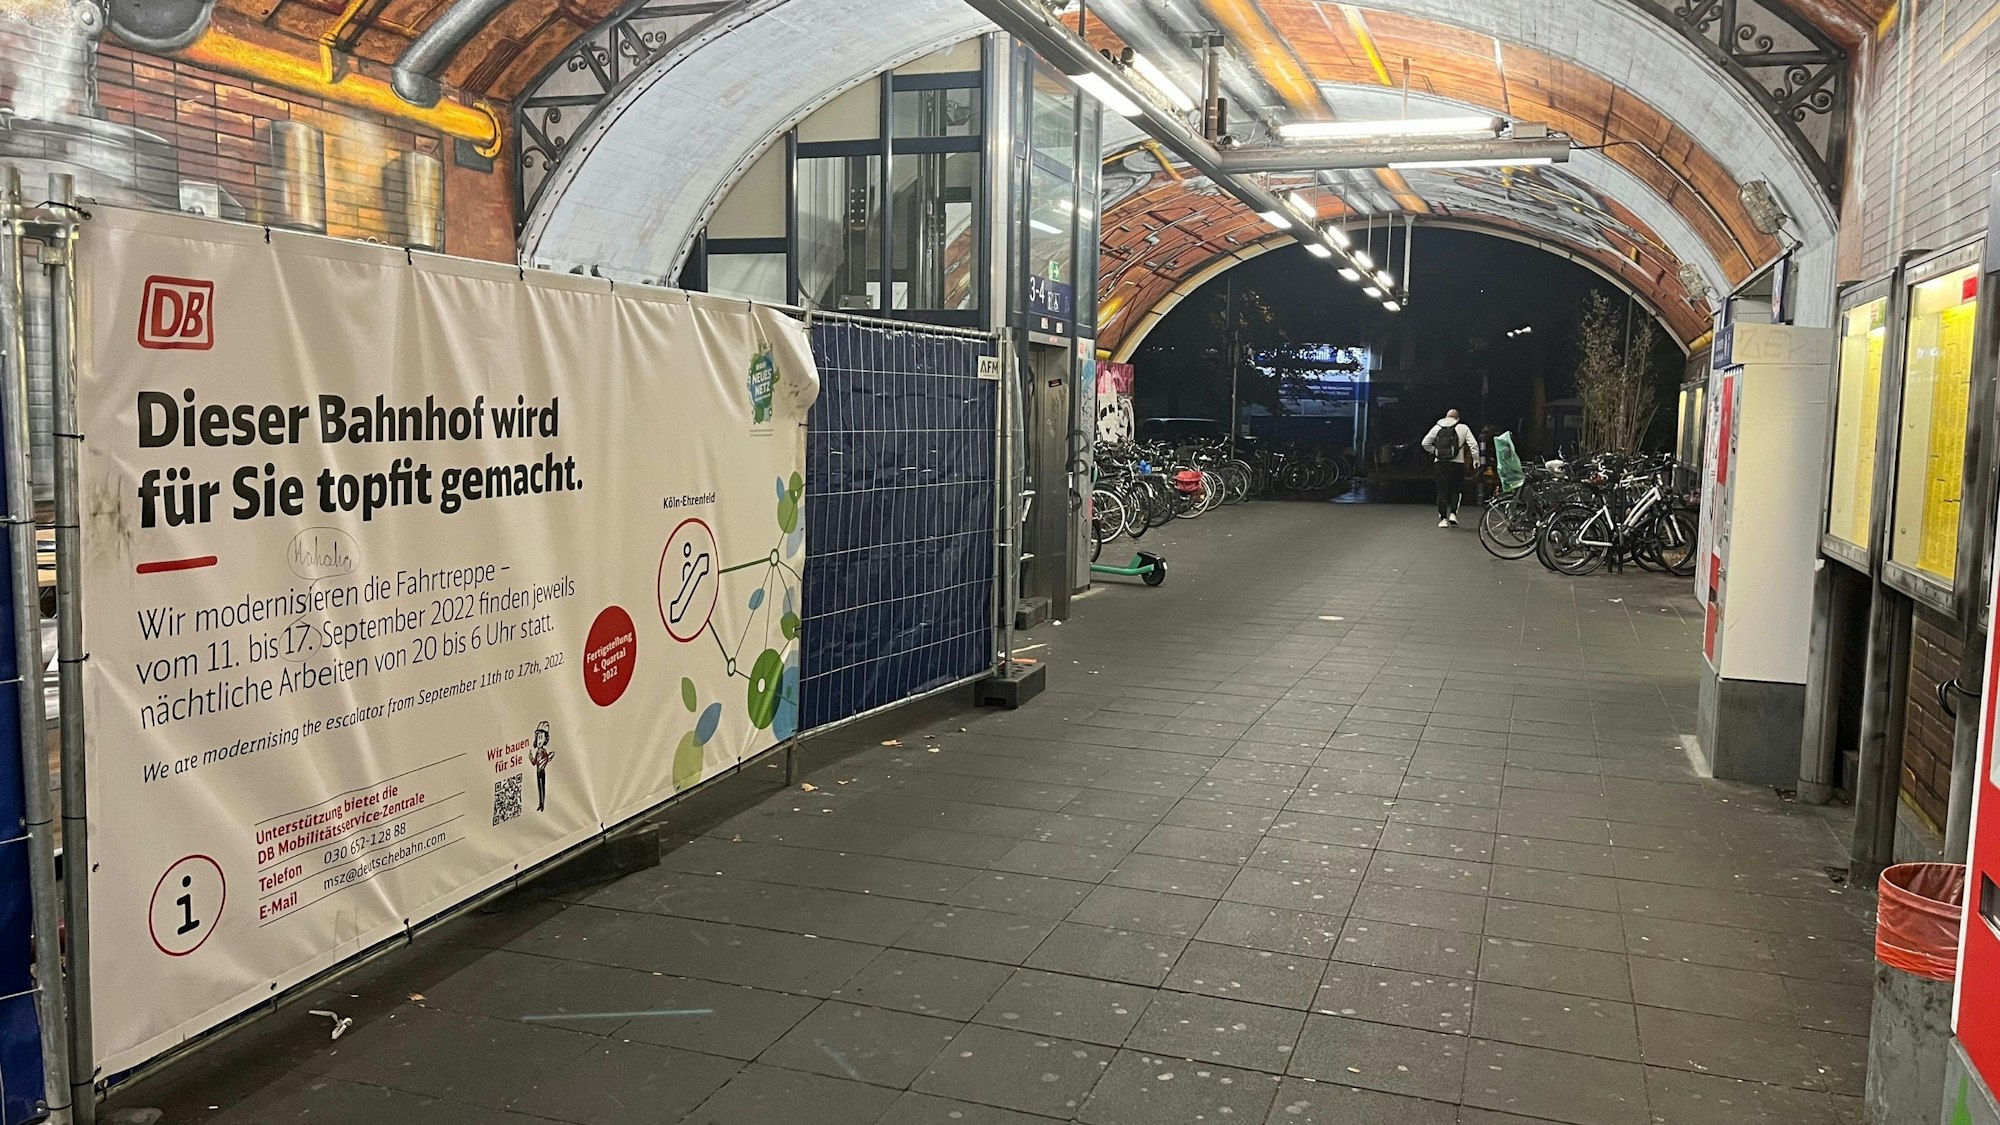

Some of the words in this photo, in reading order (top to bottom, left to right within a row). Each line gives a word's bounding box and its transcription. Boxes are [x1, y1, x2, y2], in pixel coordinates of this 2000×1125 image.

[150, 284, 205, 340] DB
[1030, 276, 1045, 304] 3-4
[752, 369, 772, 385] NEUES
[755, 383, 771, 396] NETZ
[980, 360, 999, 373] AFM
[137, 388, 309, 448] Dieser
[319, 394, 485, 444] Bahnhof
[491, 393, 558, 440] wird
[138, 467, 220, 528] für
[232, 460, 304, 521] Sie
[317, 457, 432, 522] topfit
[441, 451, 583, 514] gemacht.
[663, 492, 715, 509] Köln-Ehrenfeld
[136, 652, 198, 685] vom
[208, 639, 240, 672] 11.
[250, 632, 278, 663] bis
[285, 625, 313, 655] 17.
[322, 606, 425, 649] September
[431, 594, 474, 625] 2022
[479, 588, 529, 615] finden
[532, 575, 575, 609] jeweils
[138, 607, 186, 640] Wir
[196, 586, 358, 632] modernisieren
[364, 575, 390, 601] die
[397, 564, 495, 596] Fahrtreppe
[141, 675, 273, 729] nächtliche
[280, 657, 368, 696] Arbeiten
[375, 648, 406, 672] von
[412, 636, 437, 663] 20
[443, 633, 466, 656] bis
[471, 625, 481, 649] 6
[486, 621, 516, 645] Uhr
[521, 614, 554, 638] statt.
[587, 632, 632, 663] Fertigstellung
[593, 662, 601, 673] 4.
[601, 647, 626, 670] Quartal
[602, 666, 618, 682] 2022
[144, 763, 169, 783] We
[174, 754, 198, 775] are
[202, 727, 299, 765] modernising
[302, 719, 322, 737] the
[326, 703, 385, 730] escalator
[387, 695, 414, 718] from
[418, 679, 477, 706] September
[480, 670, 501, 688] 11th
[505, 668, 514, 681] to
[517, 660, 542, 678] 17th,
[544, 652, 565, 671] 2022.
[487, 747, 503, 761] Wir
[505, 738, 529, 755] bauen
[495, 759, 507, 773] für
[510, 754, 522, 769] Sie
[256, 805, 343, 845] Unterstützung
[344, 792, 380, 812] bietet
[382, 785, 398, 800] die
[258, 848, 274, 865] DB
[278, 792, 425, 856] Mobilitätsservice-Zentrale
[259, 865, 302, 892] Telefon
[324, 846, 348, 864] 030
[350, 829, 391, 855] 652-128
[394, 822, 406, 837] 88
[259, 891, 297, 920] E-Mail
[324, 832, 446, 890] msz@deutschebahn.com
